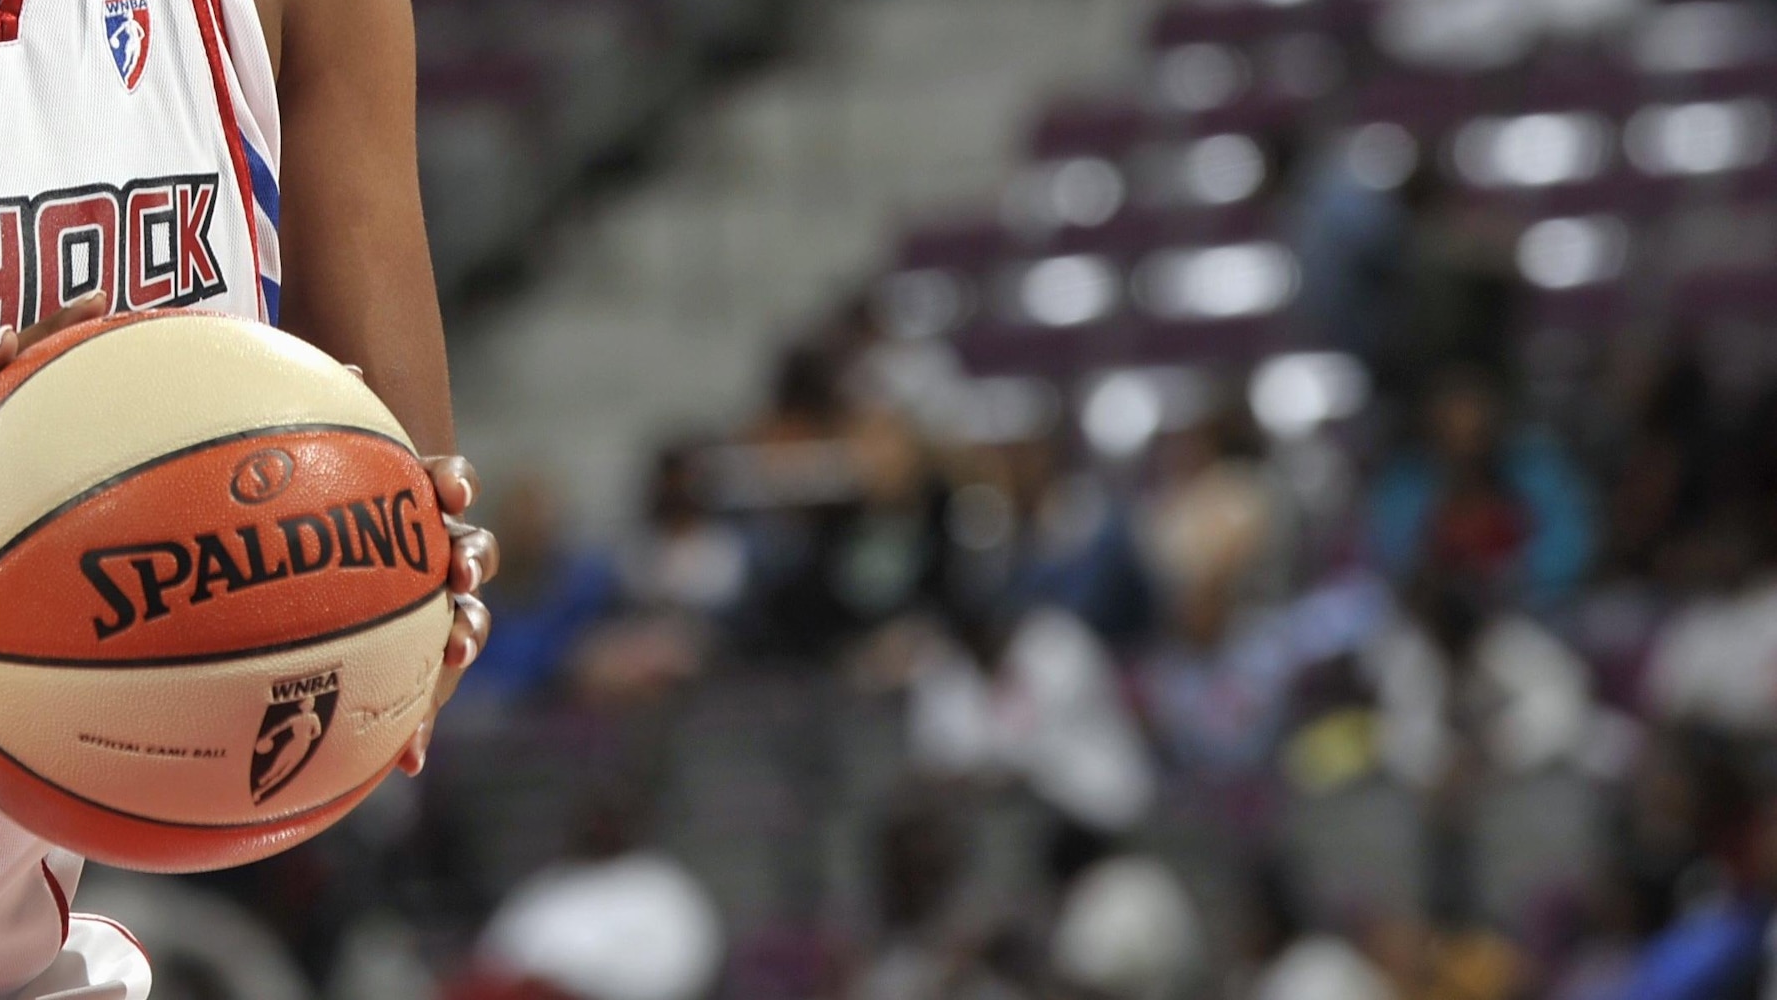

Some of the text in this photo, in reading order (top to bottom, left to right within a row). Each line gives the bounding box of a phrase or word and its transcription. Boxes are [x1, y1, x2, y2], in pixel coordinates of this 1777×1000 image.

[80, 490, 429, 642] SPALDING
[272, 672, 339, 699] WNBA
[78, 732, 227, 758] OFFICIAL GAME BALL
